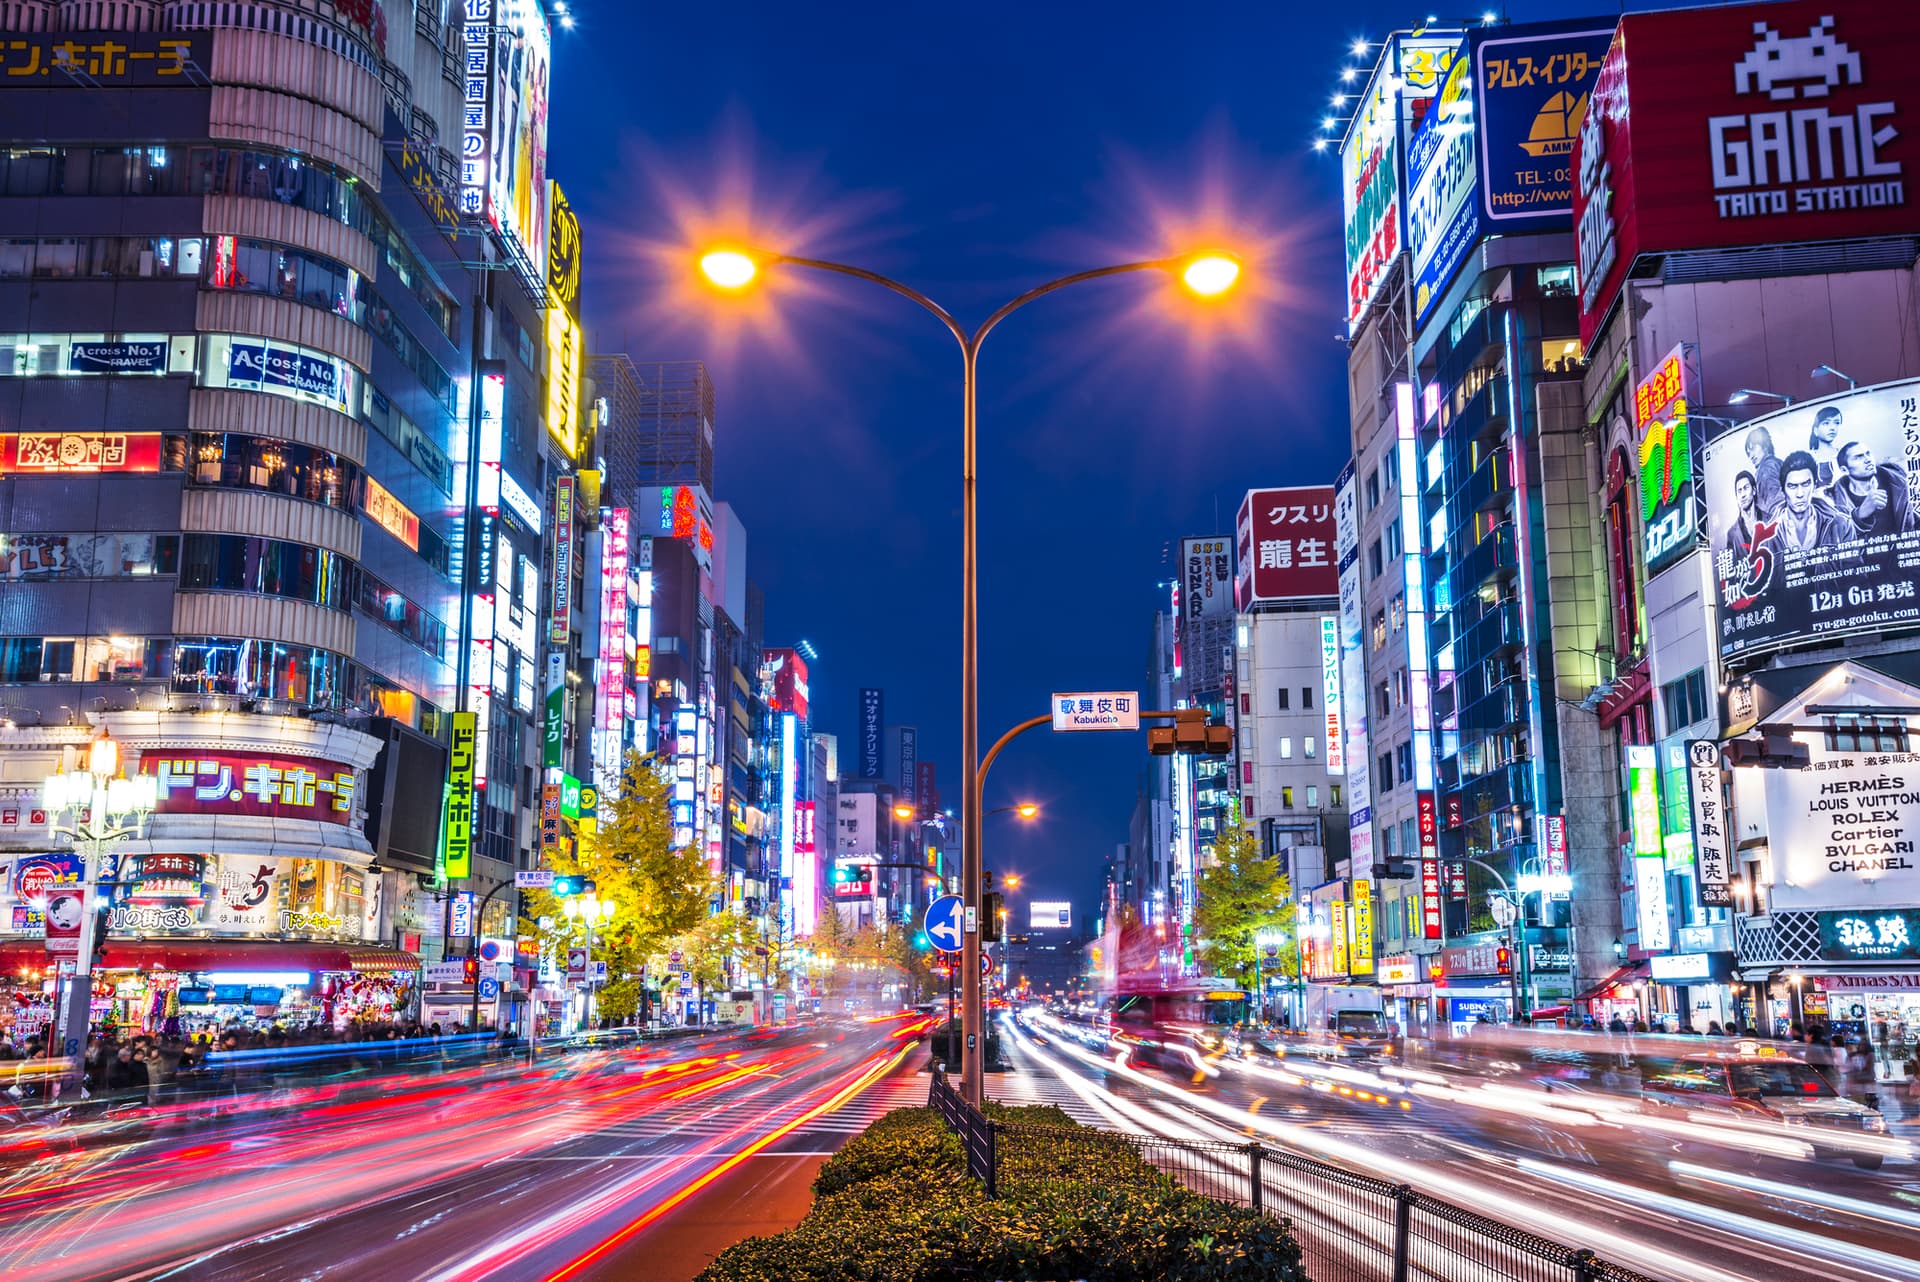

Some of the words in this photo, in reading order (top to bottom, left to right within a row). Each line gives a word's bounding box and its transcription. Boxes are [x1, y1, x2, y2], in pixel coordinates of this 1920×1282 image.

[0, 41, 191, 76] ン.キホーテ
[1486, 52, 1603, 90] アムス・インター
[1708, 101, 1902, 189] GAME
[1714, 189, 1788, 219] TAITO
[1795, 180, 1904, 212] STATION
[110, 358, 152, 367] TRAVEL
[284, 373, 337, 397] TRAVEL
[1268, 504, 1336, 525] クスリ
[1259, 538, 1338, 570] 龍生
[1215, 555, 1229, 581] NEW
[1189, 557, 1203, 618] SUNPARK
[1809, 591, 1843, 613] 12月
[1848, 585, 1873, 606] 6日
[1877, 580, 1915, 602] 発売
[1322, 620, 1338, 705] 新宿サンパーク
[1060, 698, 1130, 714] 歌舞伎町
[546, 708, 560, 743] レイク
[1074, 714, 1118, 724] Kabukicho
[866, 705, 878, 777] オザキクリニック
[1693, 743, 1714, 765] 質
[903, 732, 913, 806] 東京信用金
[450, 729, 472, 861] ドン・キホーテ
[1820, 774, 1905, 795] HERMÈS
[1810, 799, 1849, 812] LOUIS
[1857, 792, 1920, 807] VUITTON
[1832, 810, 1900, 825] ROLEX
[543, 819, 557, 844] 麻雀
[1831, 826, 1904, 842] Cartier
[1825, 841, 1914, 858] BVLGARI
[1828, 858, 1914, 872] CHANEL
[1450, 947, 1496, 971] クスリの龍生堂薬
[1836, 975, 1888, 987] Xmas
